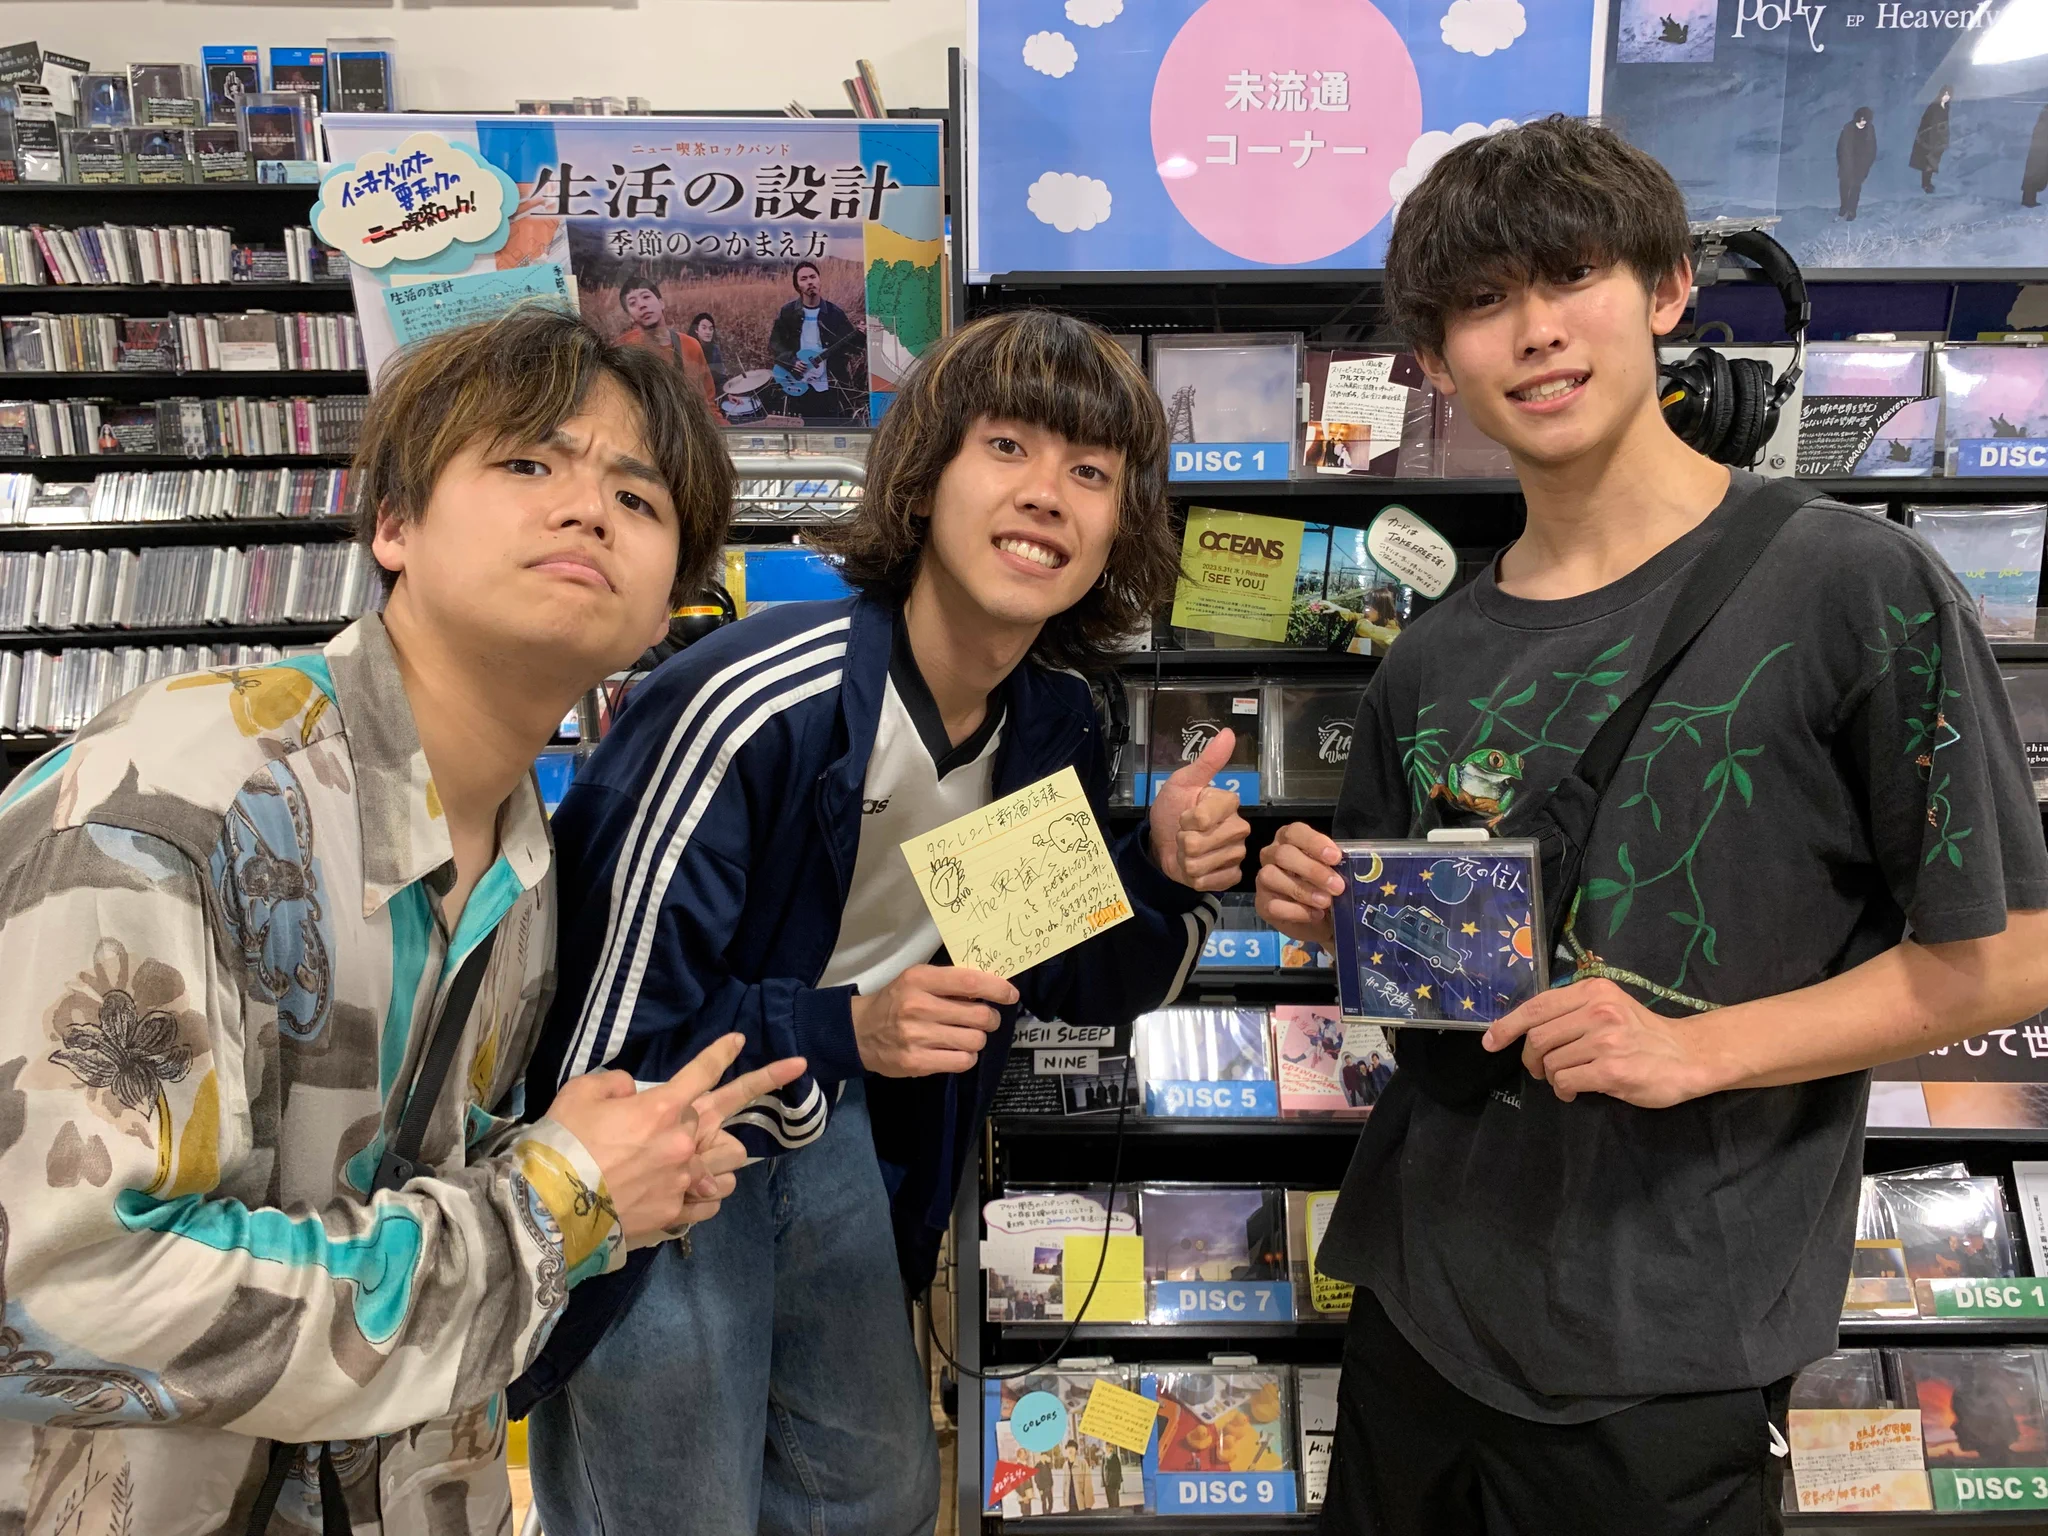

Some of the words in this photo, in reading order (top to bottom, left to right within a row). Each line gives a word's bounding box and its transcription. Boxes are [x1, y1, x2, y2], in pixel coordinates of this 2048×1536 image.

[1846, 14, 1865, 27] EP
[1875, 2, 2000, 29] Heavenly
[1224, 69, 1350, 112] 未流通
[631, 142, 790, 157] ニュー喫茶ロックバンド
[1205, 130, 1368, 169] コーナー
[529, 162, 901, 221] 生活の設計
[607, 229, 829, 258] 季節のつかまえ方
[390, 280, 454, 306] 生活の設計
[1175, 450, 1242, 472] DISC
[1253, 450, 1265, 471] 1
[1979, 446, 2047, 467] DISC
[1198, 530, 1285, 560] OCEANS
[1387, 531, 1412, 548] TAKE
[1245, 568, 1269, 579] Release
[1225, 779, 1239, 798] 2
[863, 798, 889, 815] as
[926, 783, 1067, 860] タワーレコード新宿店様
[1452, 856, 1525, 893] 夜の住人
[966, 895, 999, 924] the
[1245, 939, 1260, 957] 3
[1057, 1026, 1111, 1042] SLEEP
[1167, 1087, 1232, 1108] DISC
[1241, 1088, 1257, 1108] 5
[1179, 1289, 1246, 1312] DISC
[1255, 1290, 1271, 1311] 7
[1954, 1287, 2022, 1308] DISC
[2031, 1286, 2045, 1307] 1
[1179, 1481, 1248, 1504] DISC
[1256, 1480, 1274, 1503] 9
[1956, 1477, 2024, 1500] DISC
[2031, 1476, 2048, 1499] 3
